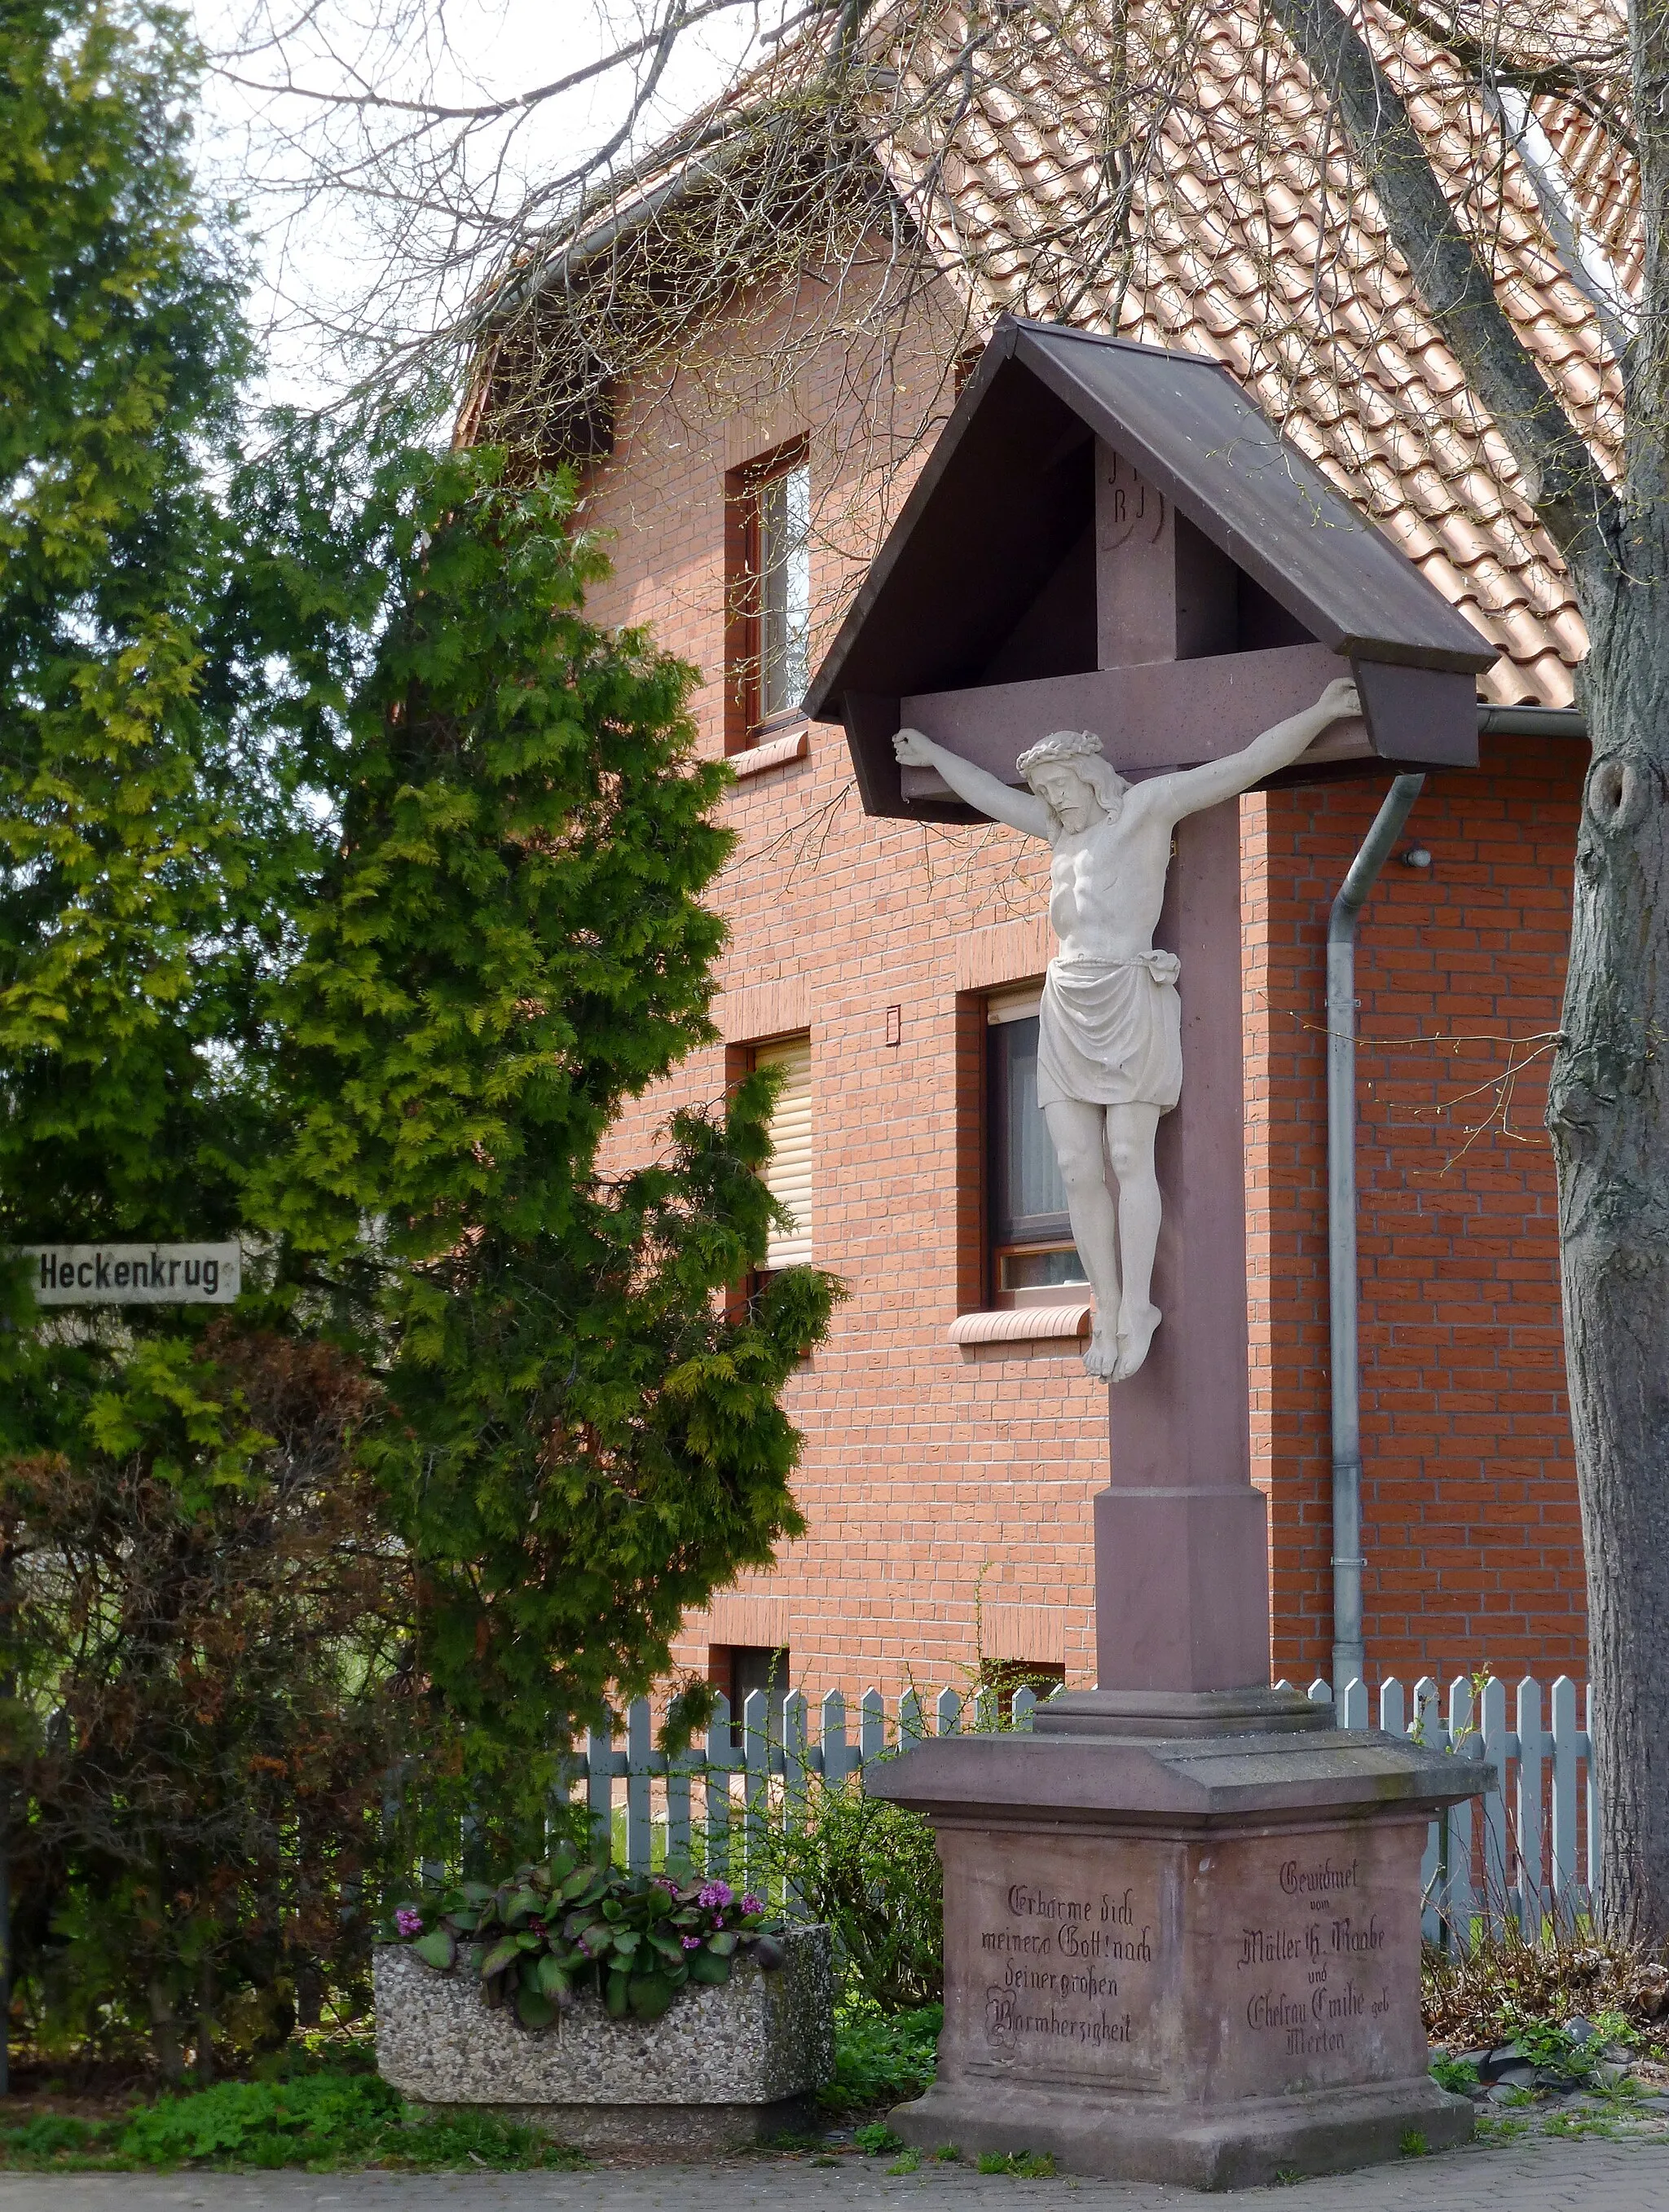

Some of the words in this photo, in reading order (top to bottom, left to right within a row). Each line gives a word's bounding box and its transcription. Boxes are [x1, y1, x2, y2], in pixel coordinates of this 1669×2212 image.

[41, 1252, 218, 1295] Heckenkrug
[1279, 1858, 1359, 1894] Gewidmet
[1007, 1884, 1091, 1922] Erbarme
[1100, 1888, 1134, 1926] dich
[1310, 1900, 1330, 1911] vom
[1237, 1928, 1301, 1970] Müller
[1331, 1914, 1385, 1952] Raabe
[1005, 1957, 1056, 1990] deiner
[1060, 1964, 1118, 2001] großen
[1307, 1962, 1327, 1984] und
[985, 1993, 1131, 2048] Barmherzigkeit
[1246, 1988, 1306, 2031] Ehefrau
[1311, 1981, 1365, 2021] Emilie
[1285, 2028, 1345, 2056] Merten
